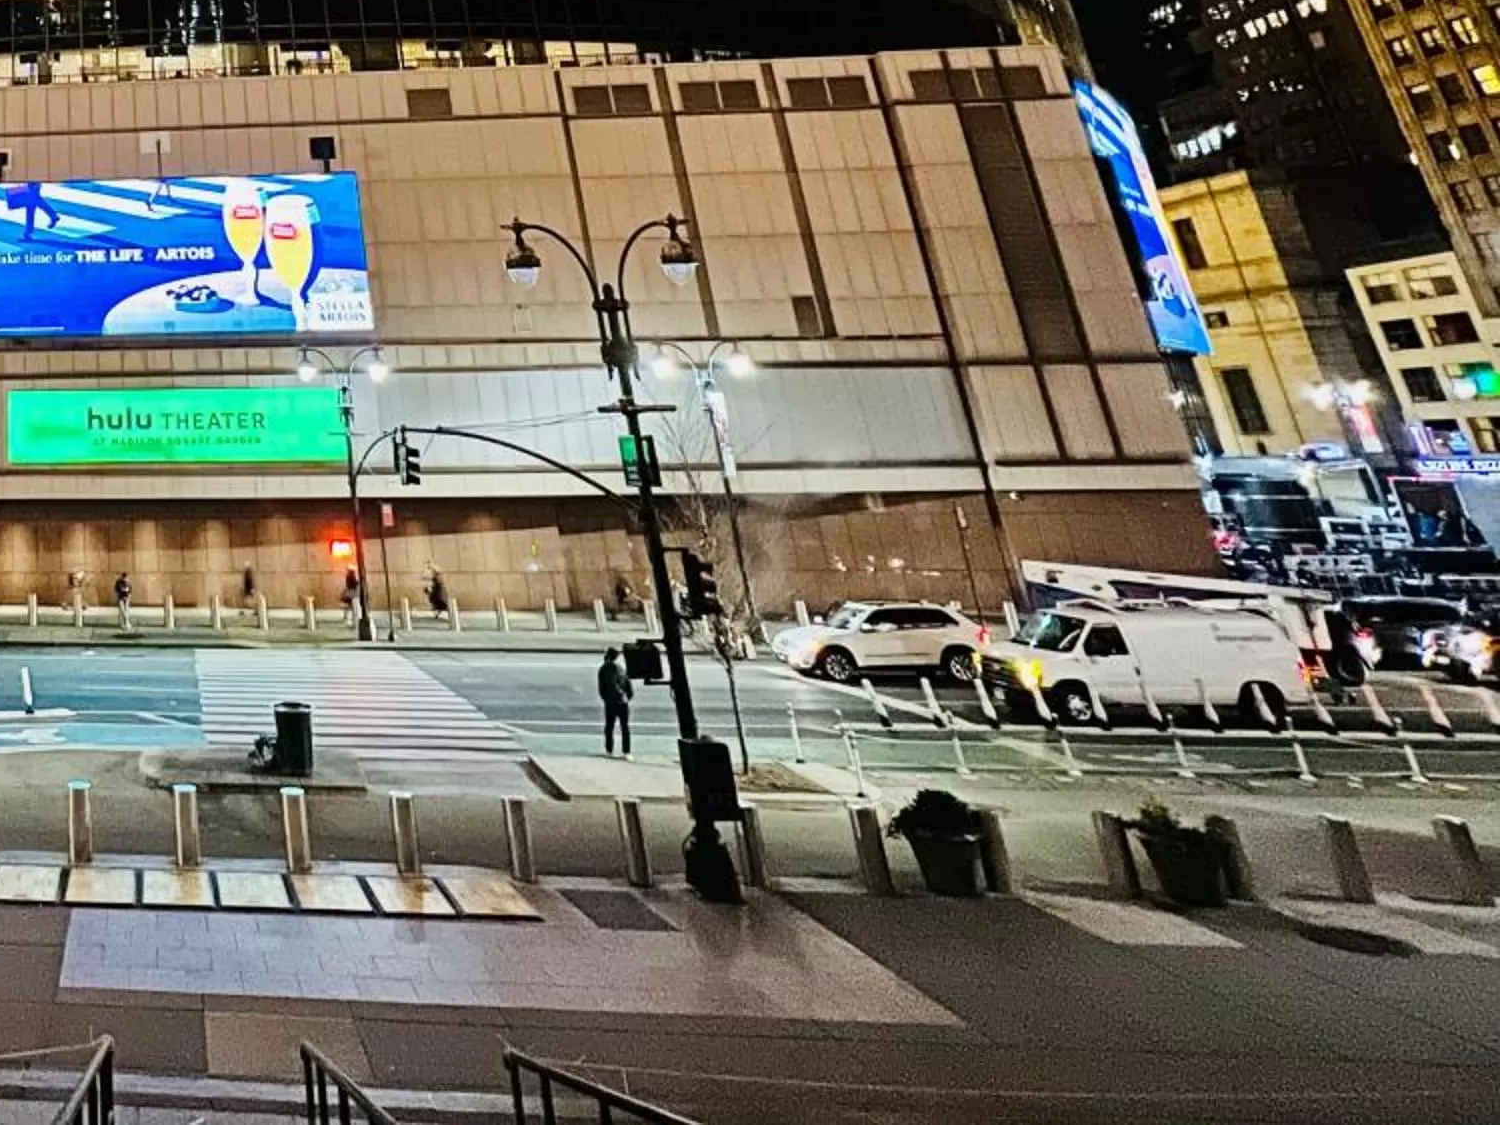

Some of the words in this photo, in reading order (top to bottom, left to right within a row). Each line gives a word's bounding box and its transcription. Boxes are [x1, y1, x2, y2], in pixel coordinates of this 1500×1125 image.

[25, 250, 52, 264] time
[56, 249, 73, 264] for
[76, 250, 107, 263] THE
[109, 248, 143, 263] LIFE
[155, 246, 215, 261] ARTOIS
[87, 406, 153, 430] hulu
[160, 412, 266, 430] THEATER
